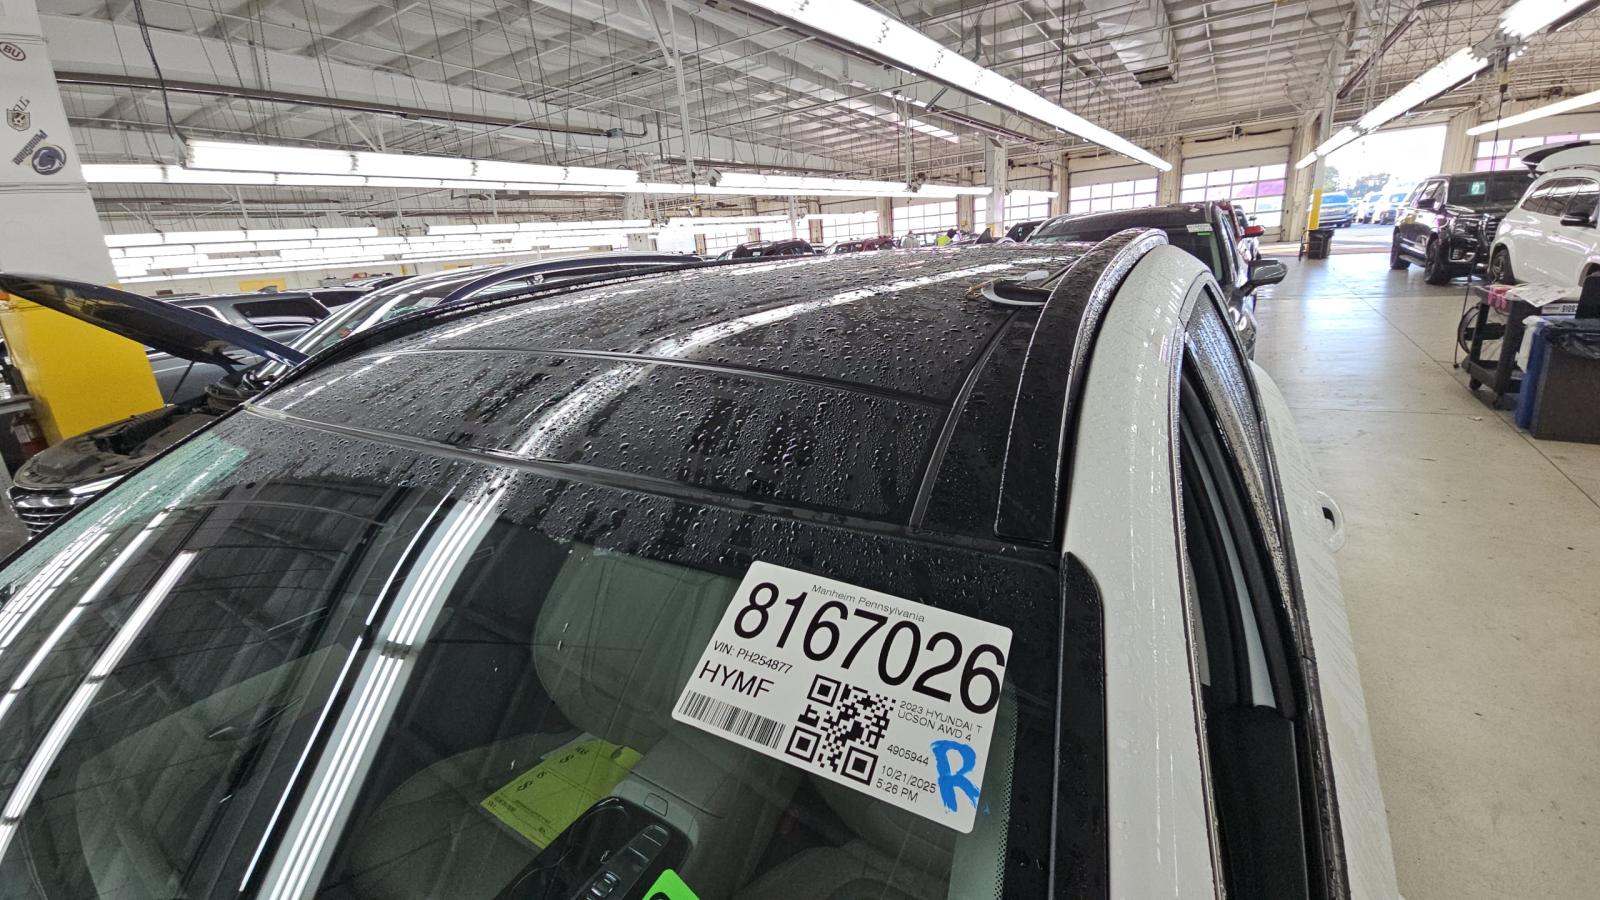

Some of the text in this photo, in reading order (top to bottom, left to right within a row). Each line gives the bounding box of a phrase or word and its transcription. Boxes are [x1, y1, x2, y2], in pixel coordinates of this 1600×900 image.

[3, 45, 21, 58] BU
[811, 584, 925, 622] Manheim Pennsylvania
[713, 640, 793, 674] VIN: PH254877
[733, 582, 1006, 714] 8167026
[698, 660, 775, 698] HYMF
[897, 710, 936, 730] UCSON
[937, 724, 963, 739] AWD
[899, 701, 923, 715] 2023
[925, 707, 976, 731] HYUNDAI
[886, 744, 930, 767] 4905944
[876, 778, 919, 803] 5:26 PM
[881, 765, 937, 794] 10/21/2025
[930, 739, 981, 813] R
